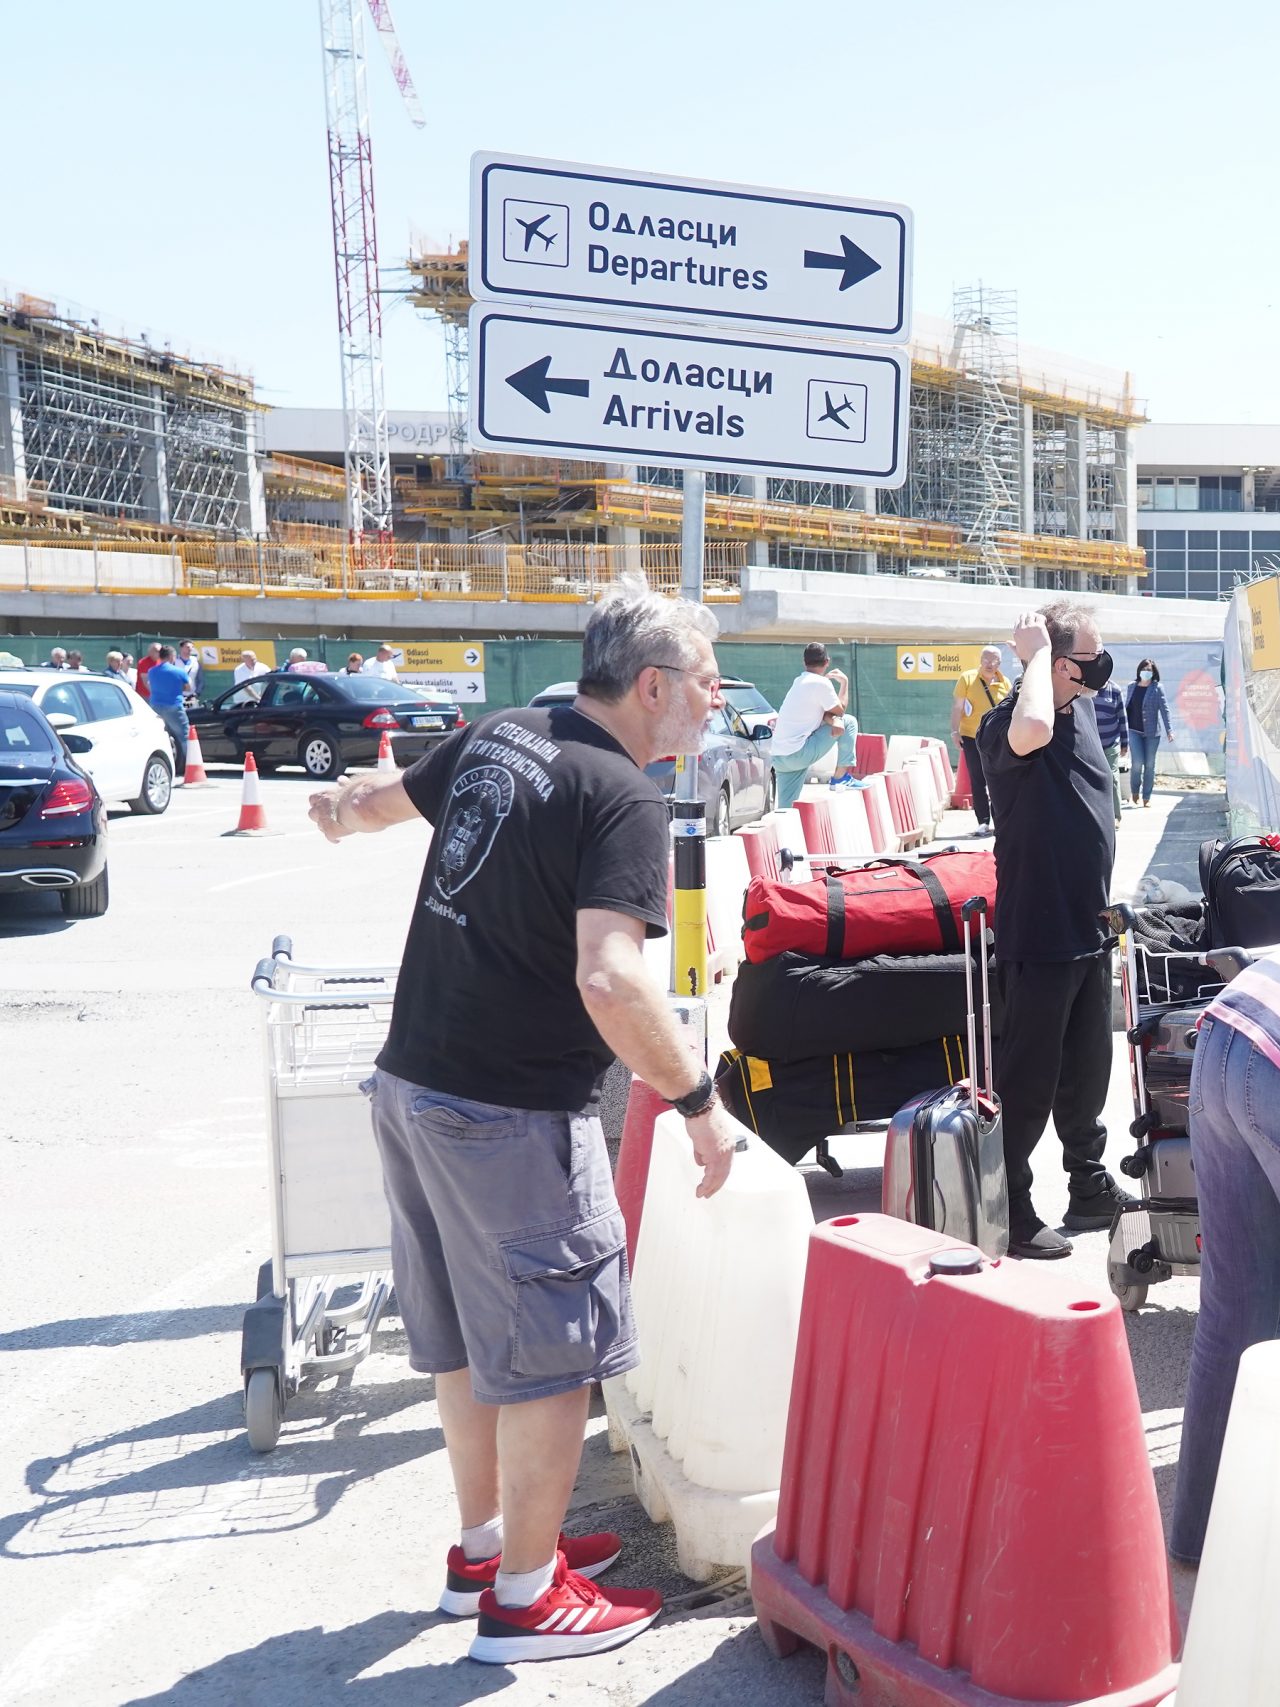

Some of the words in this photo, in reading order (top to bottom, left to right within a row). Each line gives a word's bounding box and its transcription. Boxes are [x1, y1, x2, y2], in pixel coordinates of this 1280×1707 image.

[588, 201, 738, 249] Одласци
[588, 243, 769, 291] Departures
[602, 346, 774, 398] Доласци
[602, 393, 745, 438] Arrivals
[408, 657, 443, 666] Departures
[938, 653, 960, 662] Dolasci
[938, 663, 962, 672] Arrivals
